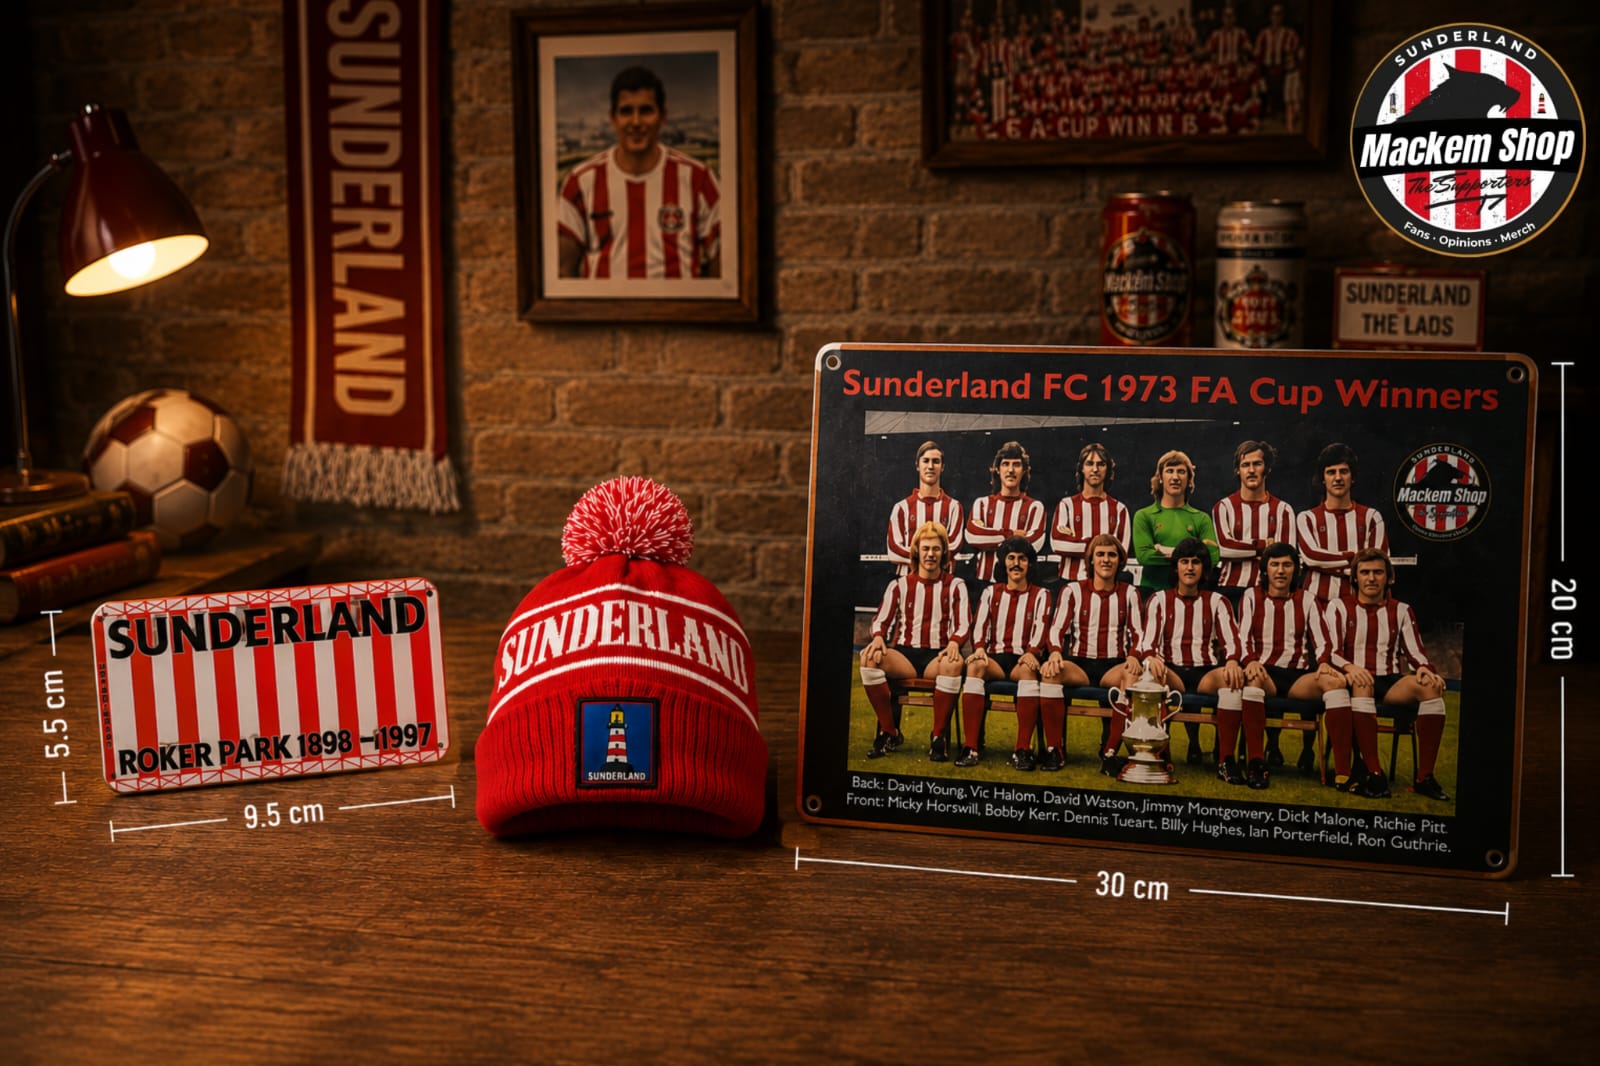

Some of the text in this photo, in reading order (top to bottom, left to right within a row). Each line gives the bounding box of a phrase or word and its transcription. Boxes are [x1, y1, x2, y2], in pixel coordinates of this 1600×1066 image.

[1057, 116, 1100, 139] CUP
[326, 0, 407, 416] SUNDERLAND
[1346, 281, 1471, 306] SUNDERLAND
[1362, 313, 1398, 335] THE
[843, 369, 1499, 415] Sunderland FC 1973 FA Cup Winners
[1397, 487, 1488, 506] Mackem Shop
[108, 595, 427, 660] SUNDERLAND
[498, 600, 748, 694] SUNDERLAND
[118, 741, 211, 776] ROKER
[218, 734, 293, 767] PARK
[297, 729, 353, 758] 1898
[588, 771, 646, 781] SUNDERLAND
[846, 793, 884, 807] Front:
[888, 796, 923, 813] Micky
[927, 799, 981, 816] Horswill,
[985, 803, 1024, 821] Bobby
[1064, 810, 1108, 826] Dennis
[1193, 821, 1245, 837] Hughes,
[1249, 825, 1269, 838] Ian
[1357, 833, 1386, 848] Ron
[1391, 836, 1451, 852] Guthrie.
[852, 776, 884, 791] Back:
[888, 778, 923, 793] David
[970, 785, 989, 799] Vic
[1044, 791, 1080, 806] David
[1084, 794, 1139, 812] Watson,
[1141, 798, 1184, 817] Jimmy
[1278, 808, 1309, 823] Dick
[1314, 811, 1369, 830] Malone,
[1373, 815, 1416, 832] Richie
